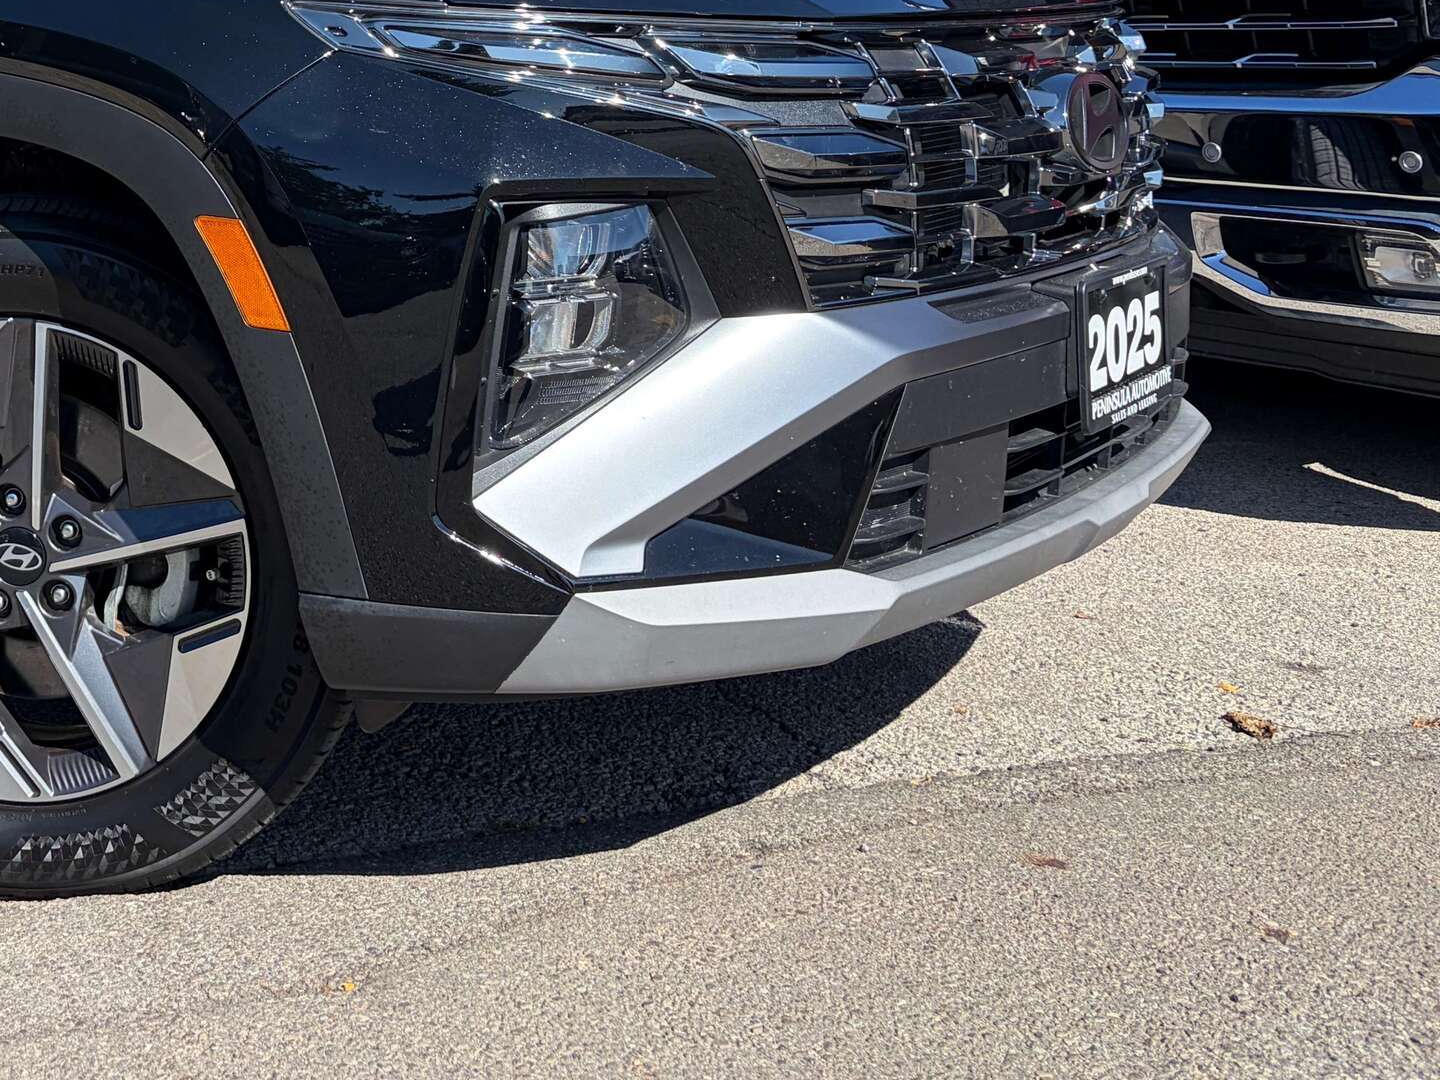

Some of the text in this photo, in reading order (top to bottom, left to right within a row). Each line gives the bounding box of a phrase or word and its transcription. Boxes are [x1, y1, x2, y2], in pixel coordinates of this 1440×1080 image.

[1088, 290, 1162, 393] 2025
[1091, 365, 1172, 420] PENINSULA AUTOMOTIVE
